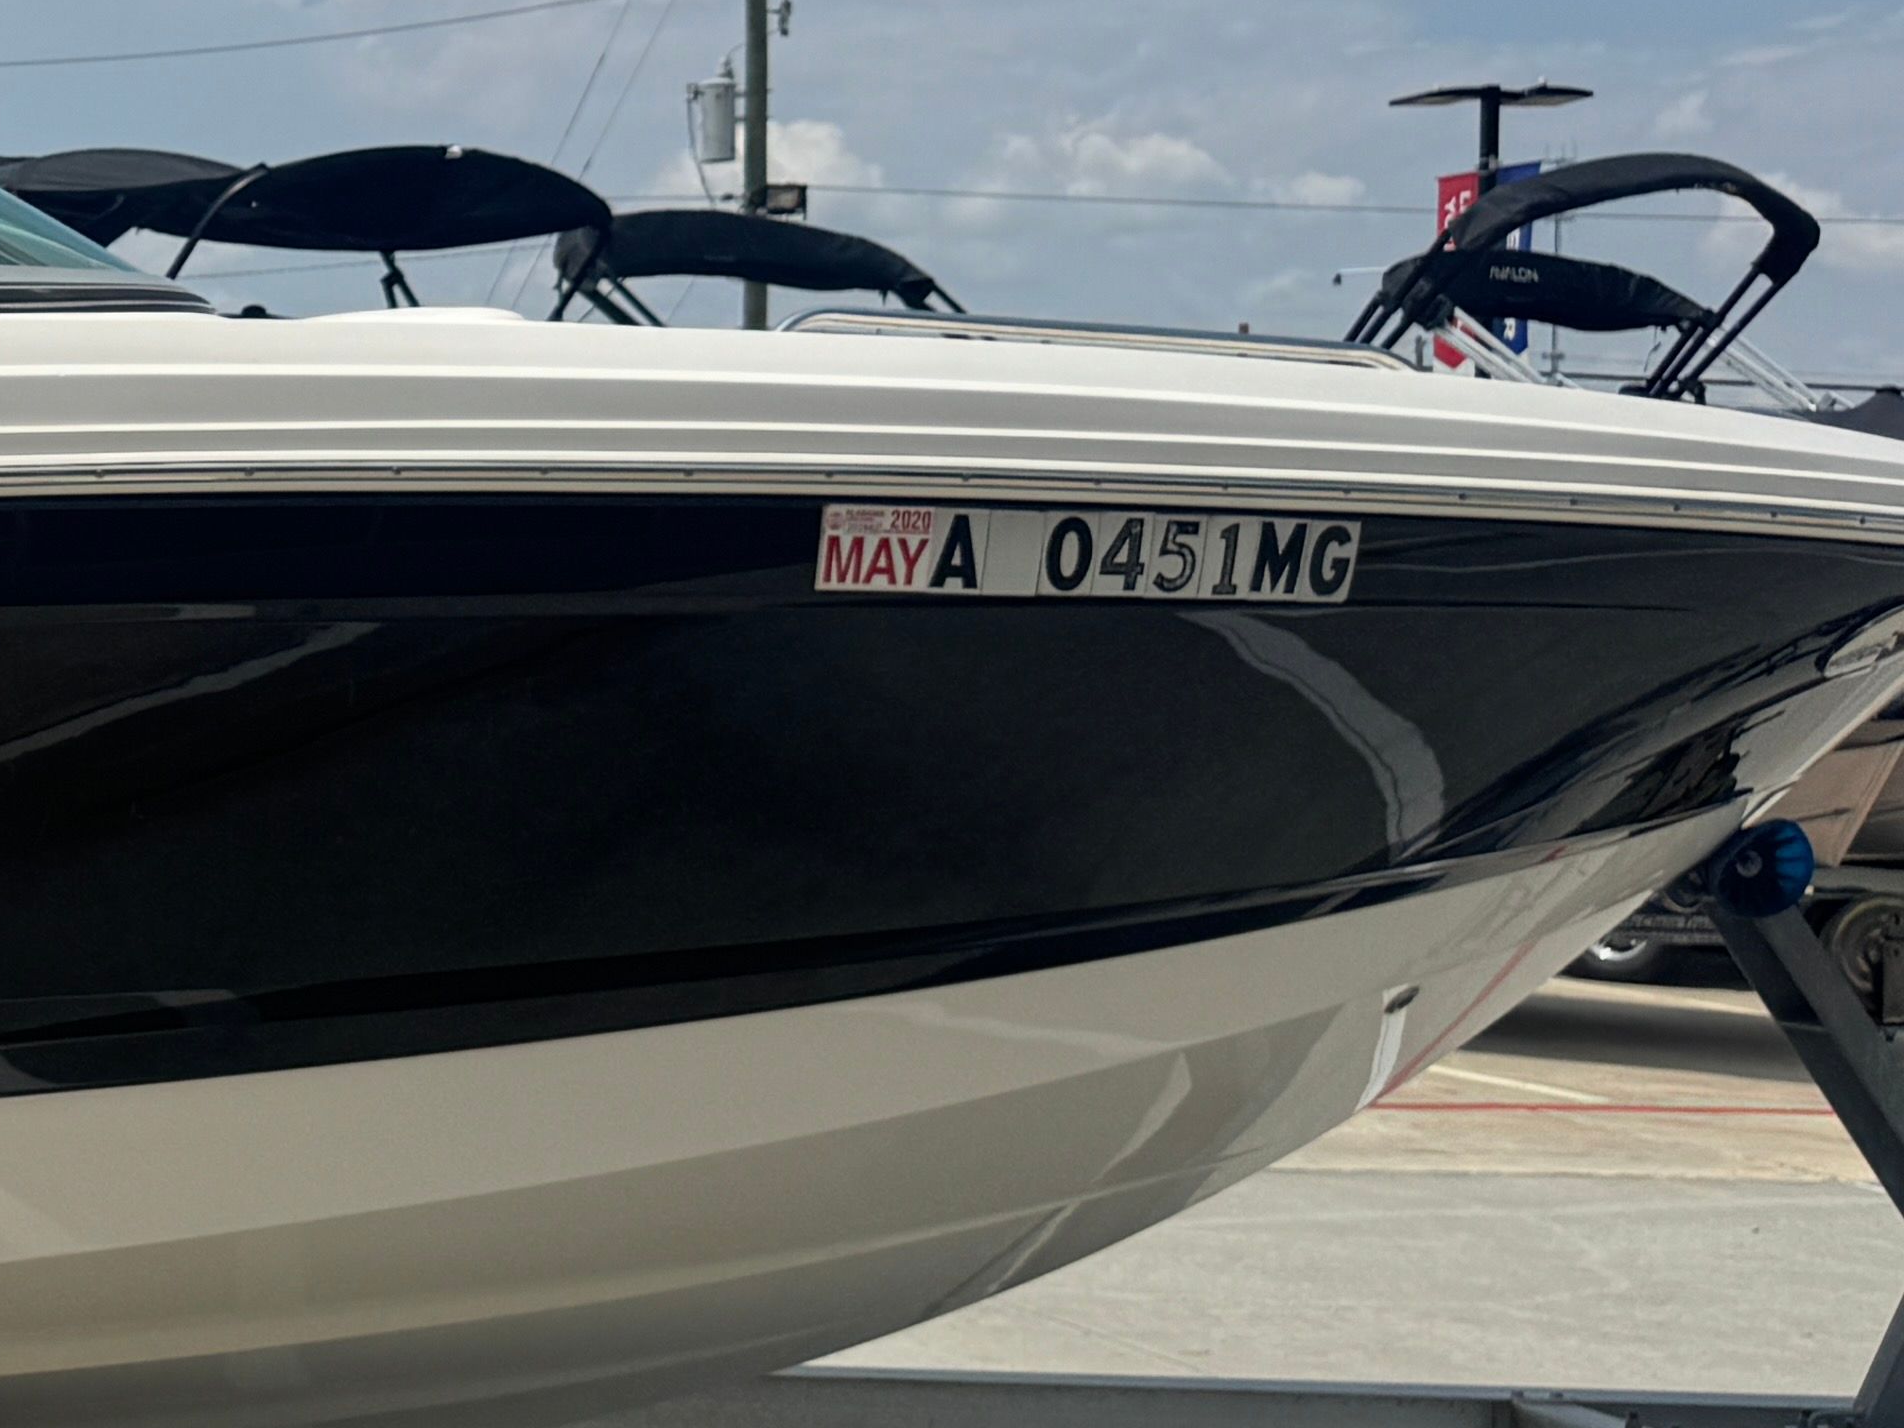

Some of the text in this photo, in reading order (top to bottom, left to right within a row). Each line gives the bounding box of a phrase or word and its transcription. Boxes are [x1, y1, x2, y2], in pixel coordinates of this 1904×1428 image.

[1489, 265, 1539, 283] AVALON
[890, 509, 933, 532] 2020
[822, 535, 930, 586] MAY
[929, 514, 978, 589] A
